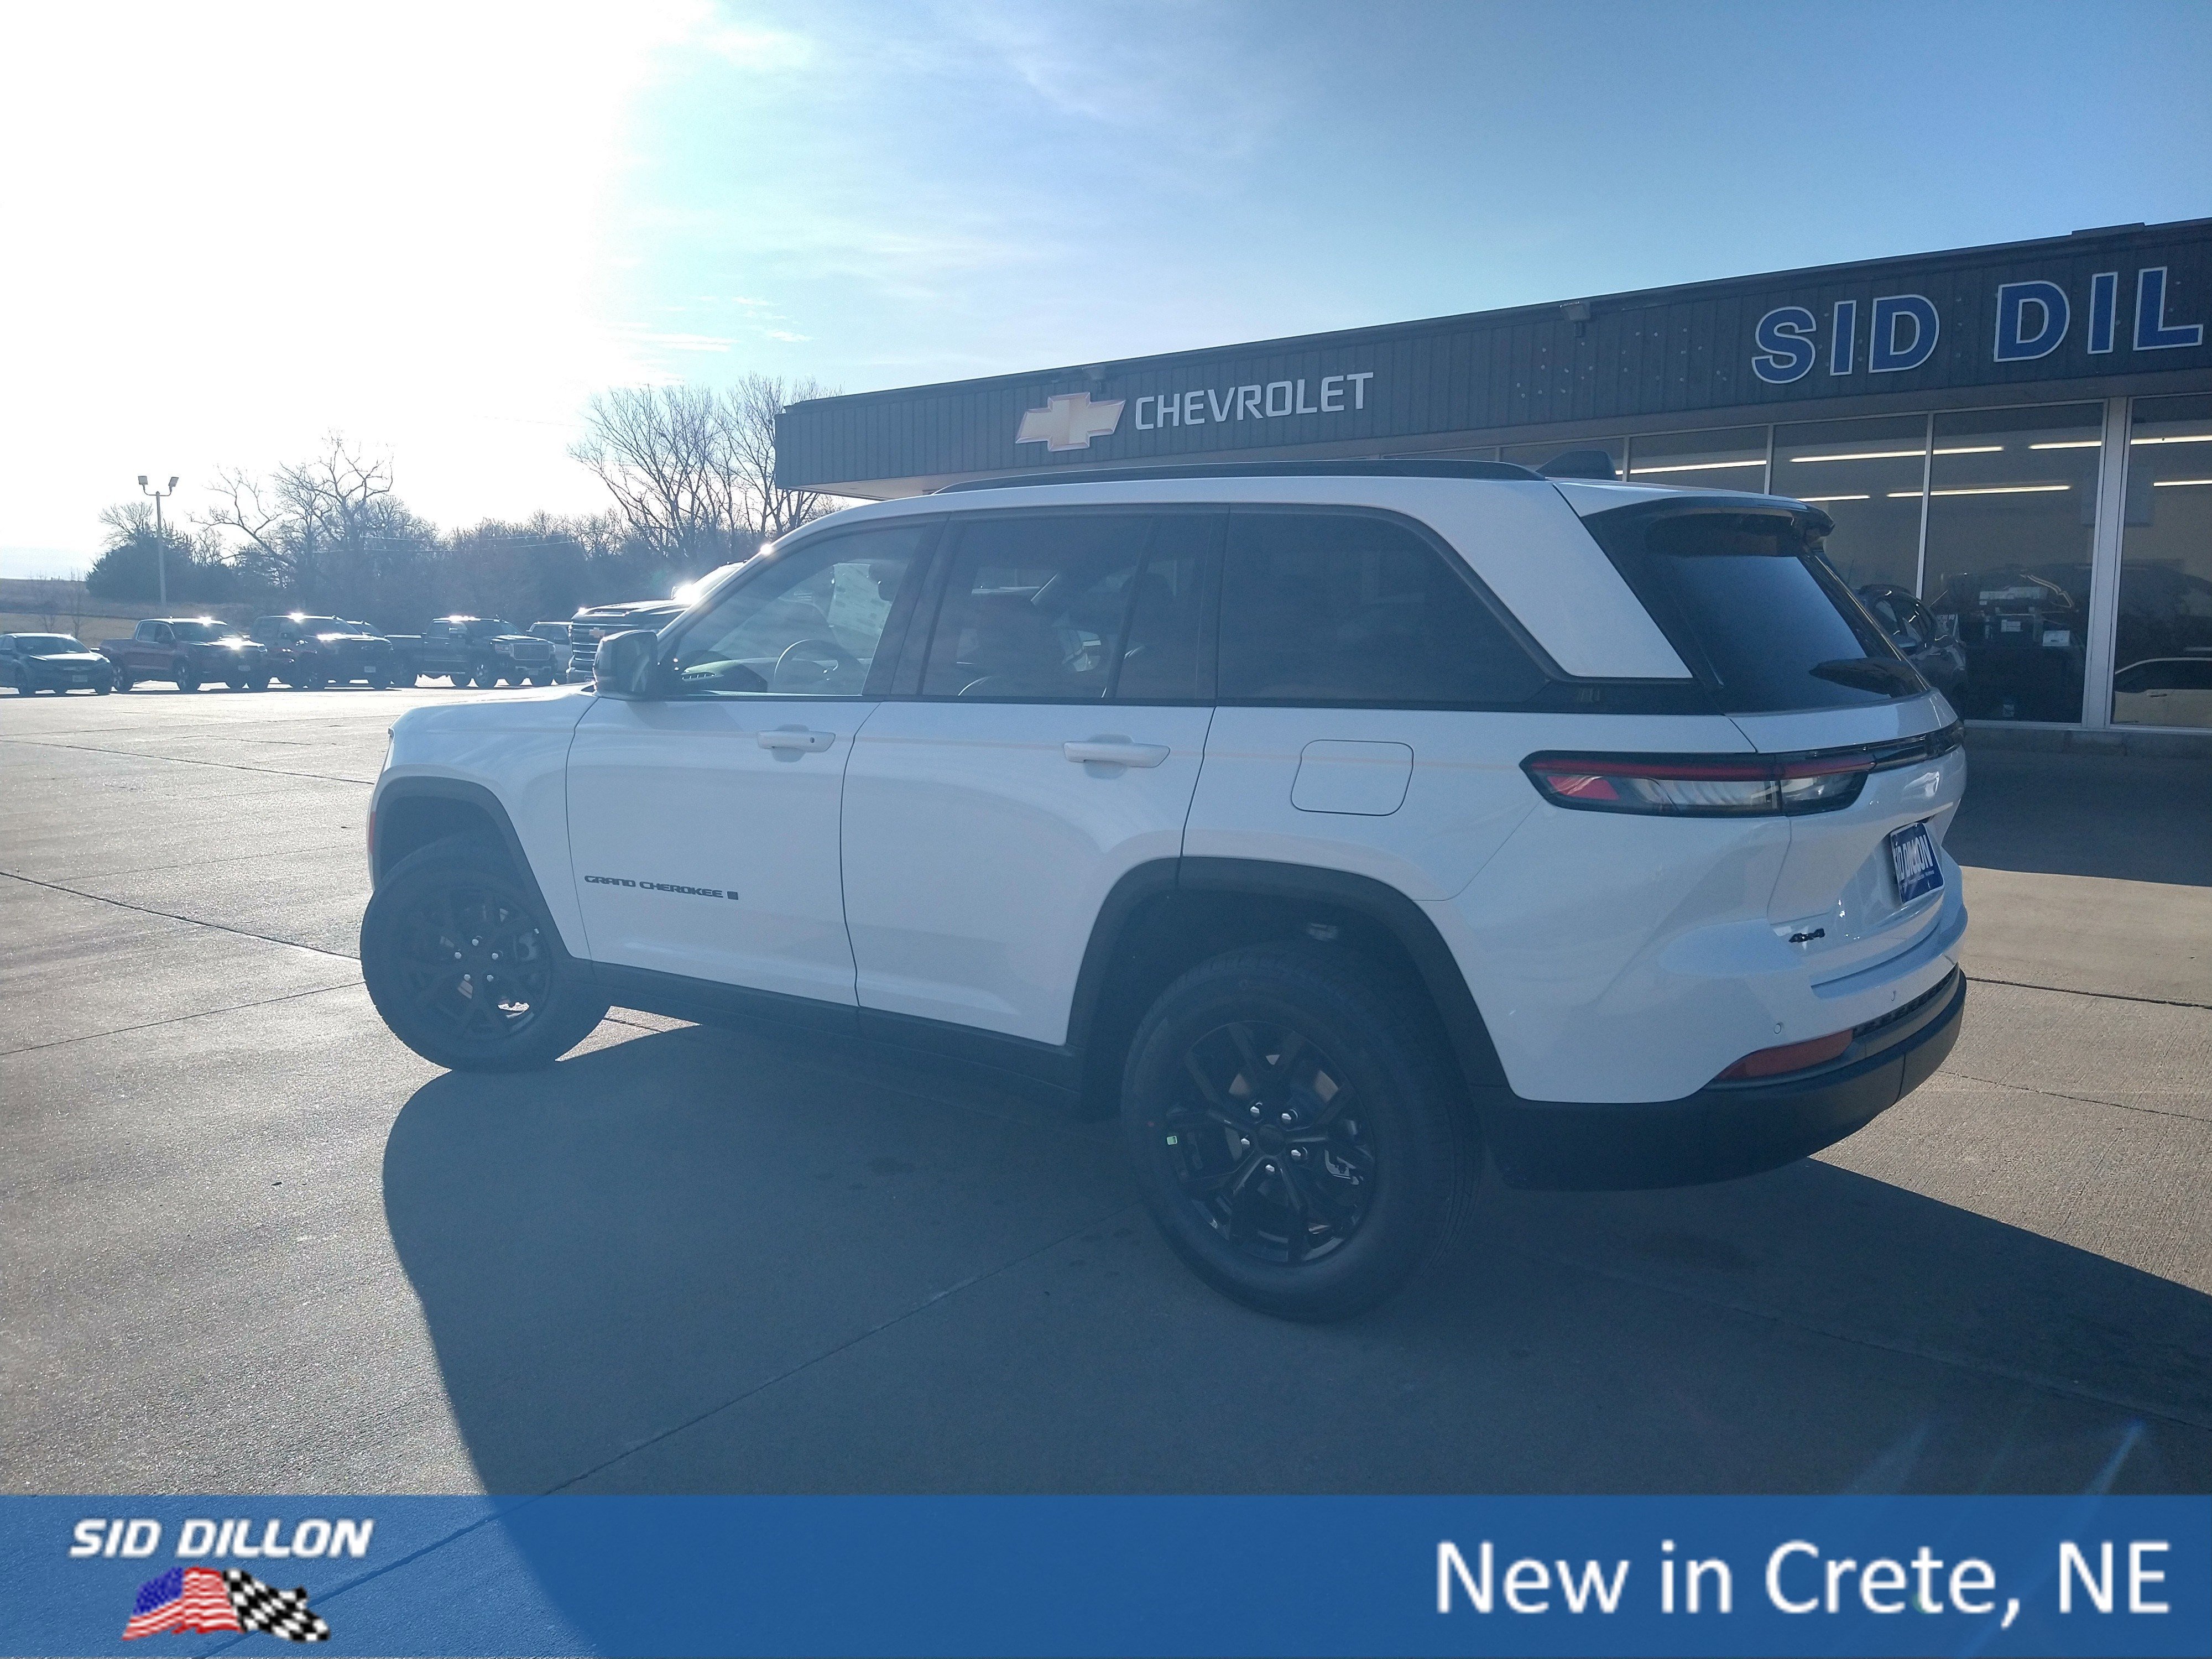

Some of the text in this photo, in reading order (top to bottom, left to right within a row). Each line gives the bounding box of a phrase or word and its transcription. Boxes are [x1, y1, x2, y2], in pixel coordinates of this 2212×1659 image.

[1751, 266, 2203, 384] SID DIL
[1135, 372, 1374, 431] CHEVROLET
[1902, 834, 1933, 878] DILLON
[584, 875, 723, 898] GRAND CHEROKEE
